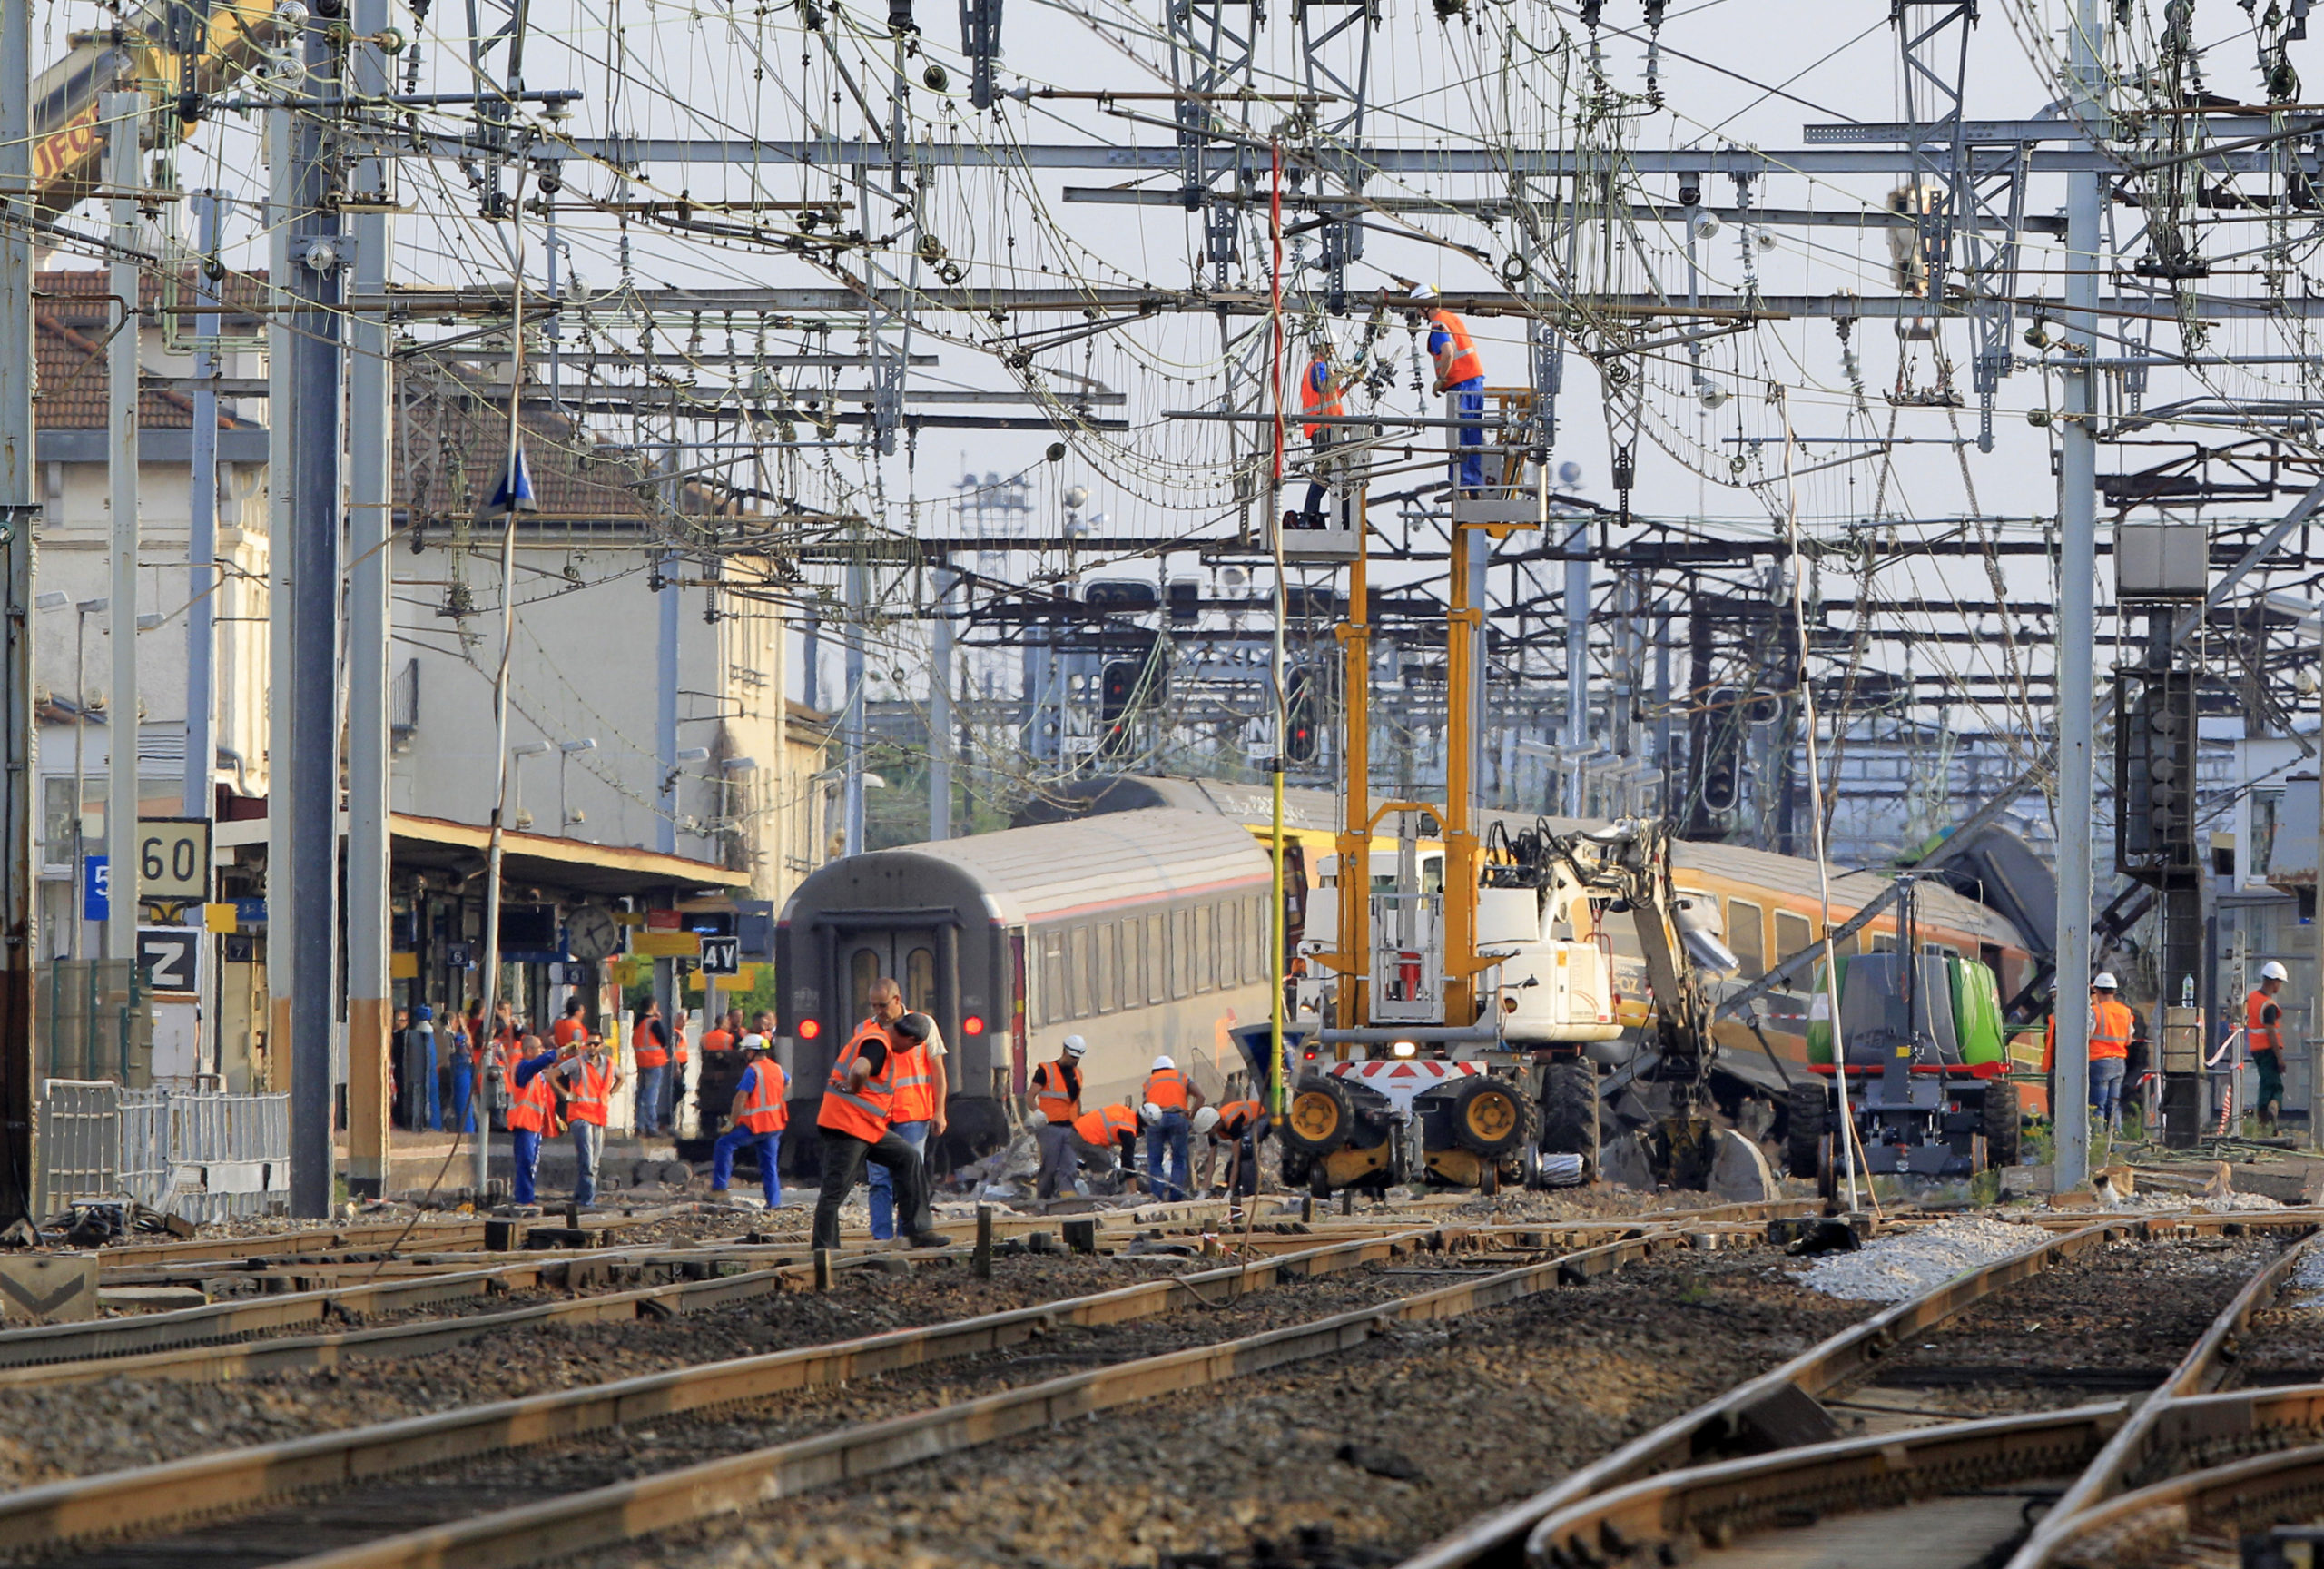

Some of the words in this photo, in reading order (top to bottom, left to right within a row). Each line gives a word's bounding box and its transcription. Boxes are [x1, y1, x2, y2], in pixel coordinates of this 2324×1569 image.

[142, 837, 195, 882] 60
[94, 864, 110, 896] 5
[144, 942, 185, 986] Z
[454, 952, 462, 962] 6
